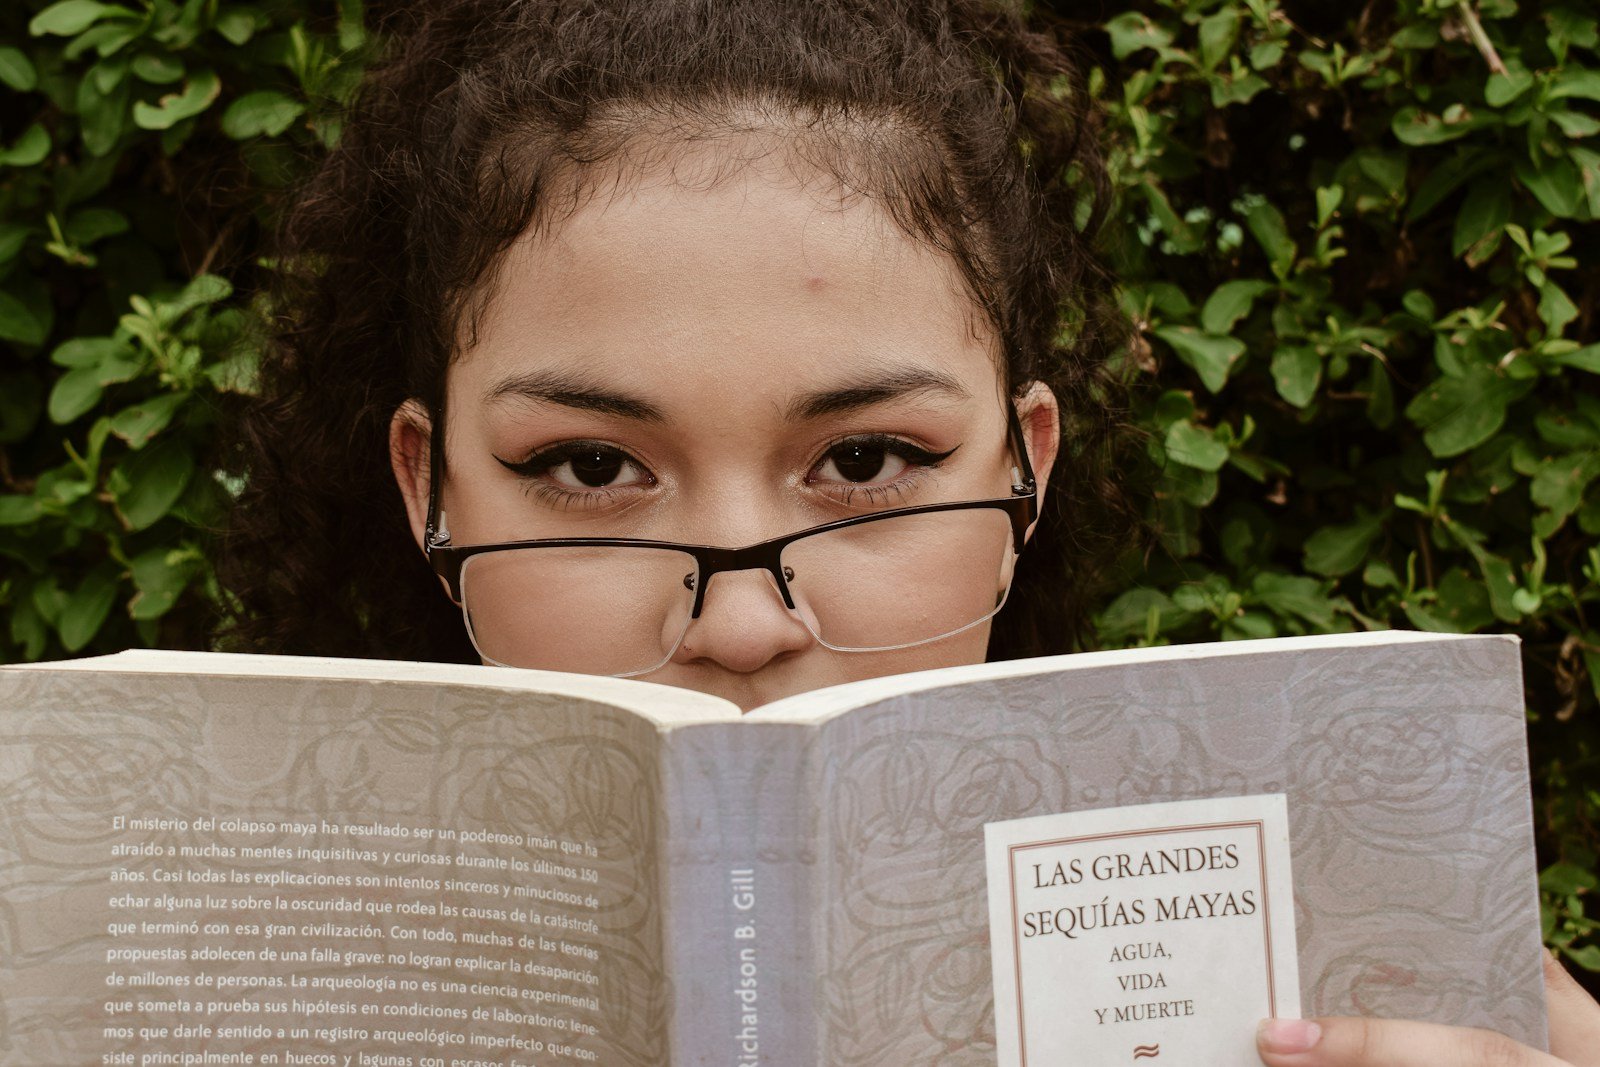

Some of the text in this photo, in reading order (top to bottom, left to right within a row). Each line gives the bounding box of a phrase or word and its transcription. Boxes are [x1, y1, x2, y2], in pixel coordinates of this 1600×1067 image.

[113, 816, 598, 857] El misterio del colapso maya ha resultado ser un poderoso imán que ha
[112, 842, 598, 883] atraído a muchas mentes inquisitivas y curiosas durante los últimos 150
[1033, 844, 1239, 889] LAS GRANDES
[111, 868, 598, 908] años. Casi todas las explicaciones son intentos sinceros y minuciosos de
[731, 869, 754, 910] Gill
[109, 894, 598, 934] echar alguna luz sobre la oscuridad que rodea las causas de la catástrofe
[734, 919, 756, 938] B.
[1024, 890, 1256, 939] SEQUÍAS MAYAS
[108, 921, 598, 960] que terminó con esa gran civilización. Con todo, muchas de las teorías
[1109, 942, 1172, 962] AGUA,
[107, 947, 598, 986] propuestas adolecen de una falla grave: no logran explicar la desaparición
[1118, 973, 1167, 991] VIDA
[106, 973, 598, 1011] de millones de personas. La arqueología no es una ciencia experimental
[105, 999, 599, 1036] que someta a prueba sus hipótesis en condiciones de laboratorio: tene-
[1095, 1000, 1194, 1024] Y MUERTE
[103, 1051, 134, 1064] siste
[142, 1050, 253, 1067] principalmente
[260, 1053, 278, 1064] en
[286, 1051, 336, 1064] huecos
[344, 1055, 352, 1067] y
[359, 1051, 412, 1067] lagunas
[420, 1056, 444, 1067] con
[104, 1025, 599, 1062] mos que darle sentido a un registro arqueológico imperfecto que con-
